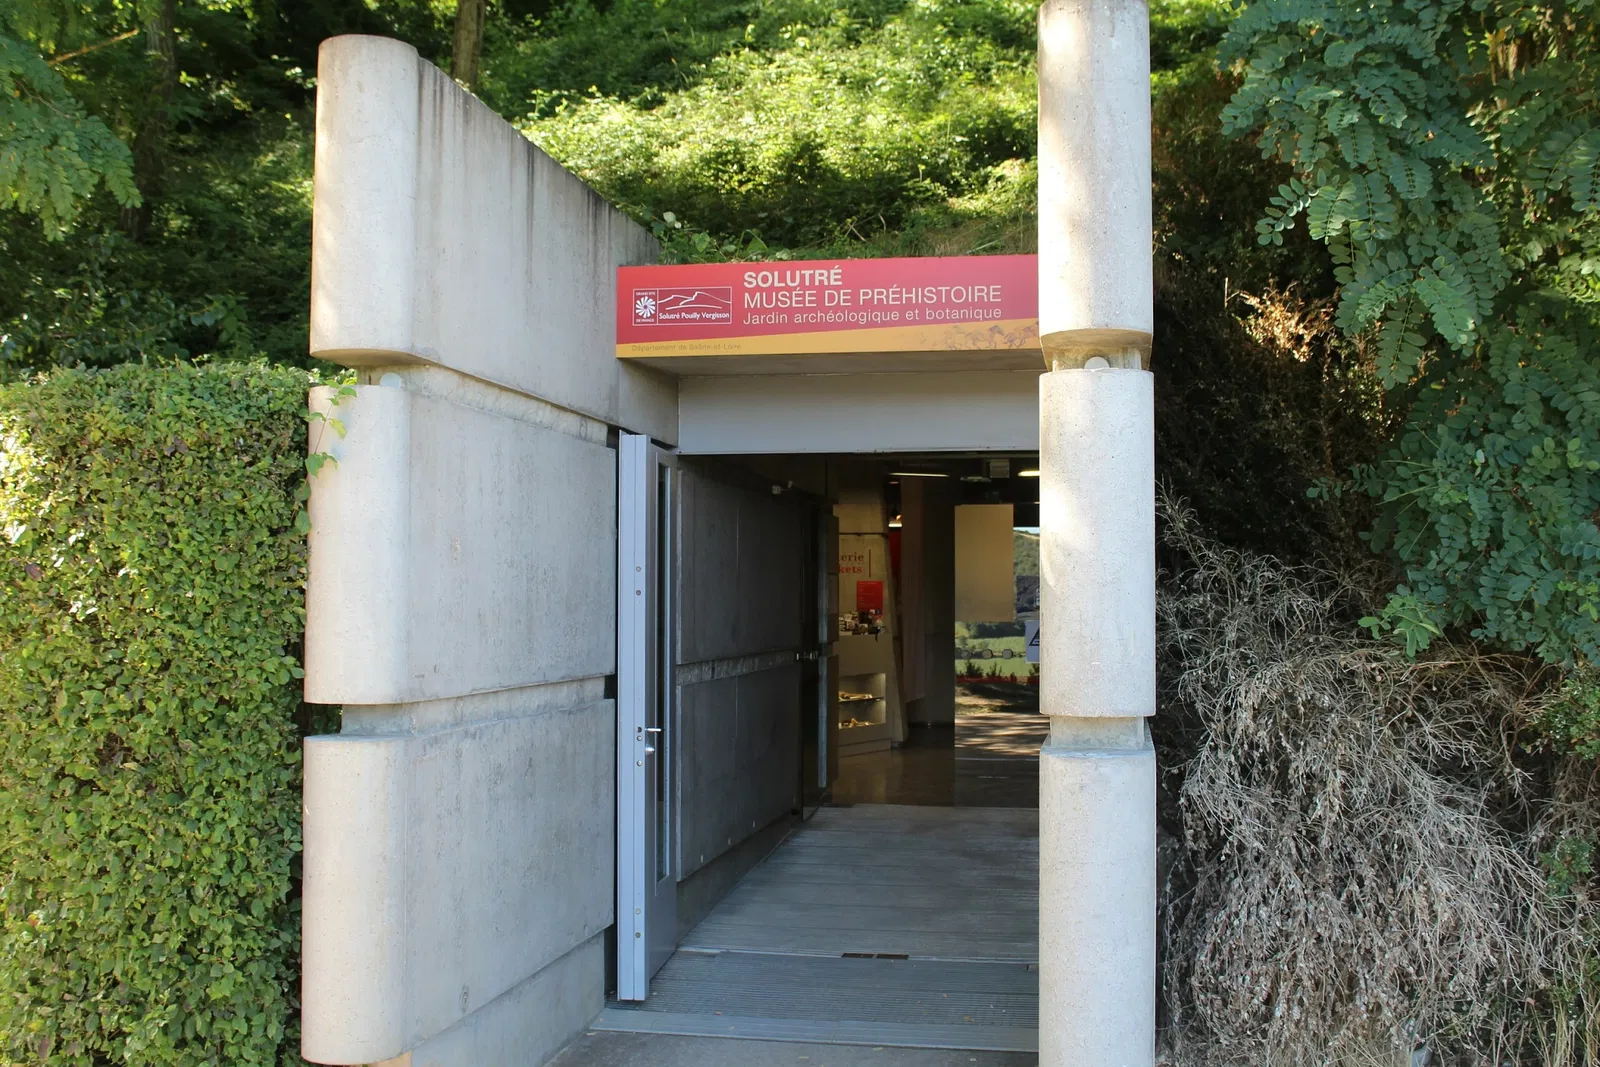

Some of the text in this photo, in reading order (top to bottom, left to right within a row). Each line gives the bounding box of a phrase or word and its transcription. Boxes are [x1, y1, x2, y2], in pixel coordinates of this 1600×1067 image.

[743, 265, 843, 288] SOLUTRÉ
[744, 284, 1002, 309] MUSÉE DE PRÉHISTOIRE
[658, 312, 730, 321] Solutré Pouilly Vergisson
[743, 306, 1002, 325] Jardin archéologique et botanique
